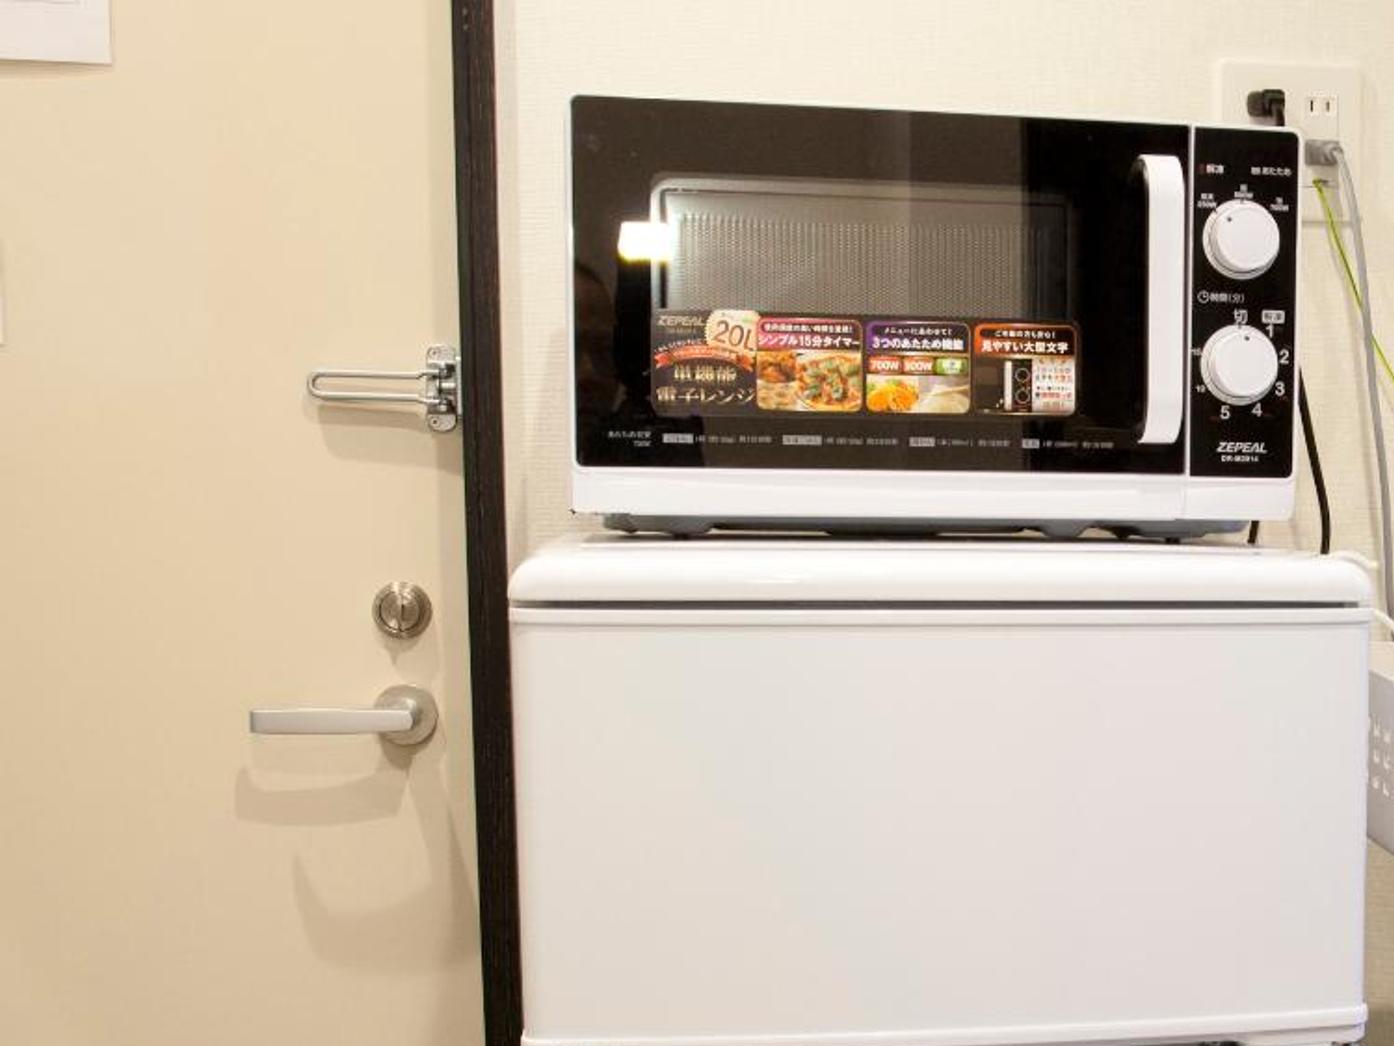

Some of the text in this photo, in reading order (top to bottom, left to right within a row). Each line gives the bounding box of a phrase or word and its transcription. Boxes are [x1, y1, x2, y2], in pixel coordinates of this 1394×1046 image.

[1234, 308, 1248, 325] 切
[713, 319, 755, 352] 20L
[1265, 325, 1275, 338] 1
[758, 333, 860, 348] シンプル15分タイマー
[1279, 350, 1290, 365] 2
[1274, 381, 1286, 396] 3
[1219, 405, 1231, 420] 5
[1251, 402, 1263, 418] 4
[1216, 441, 1268, 454] ZEPEAL
